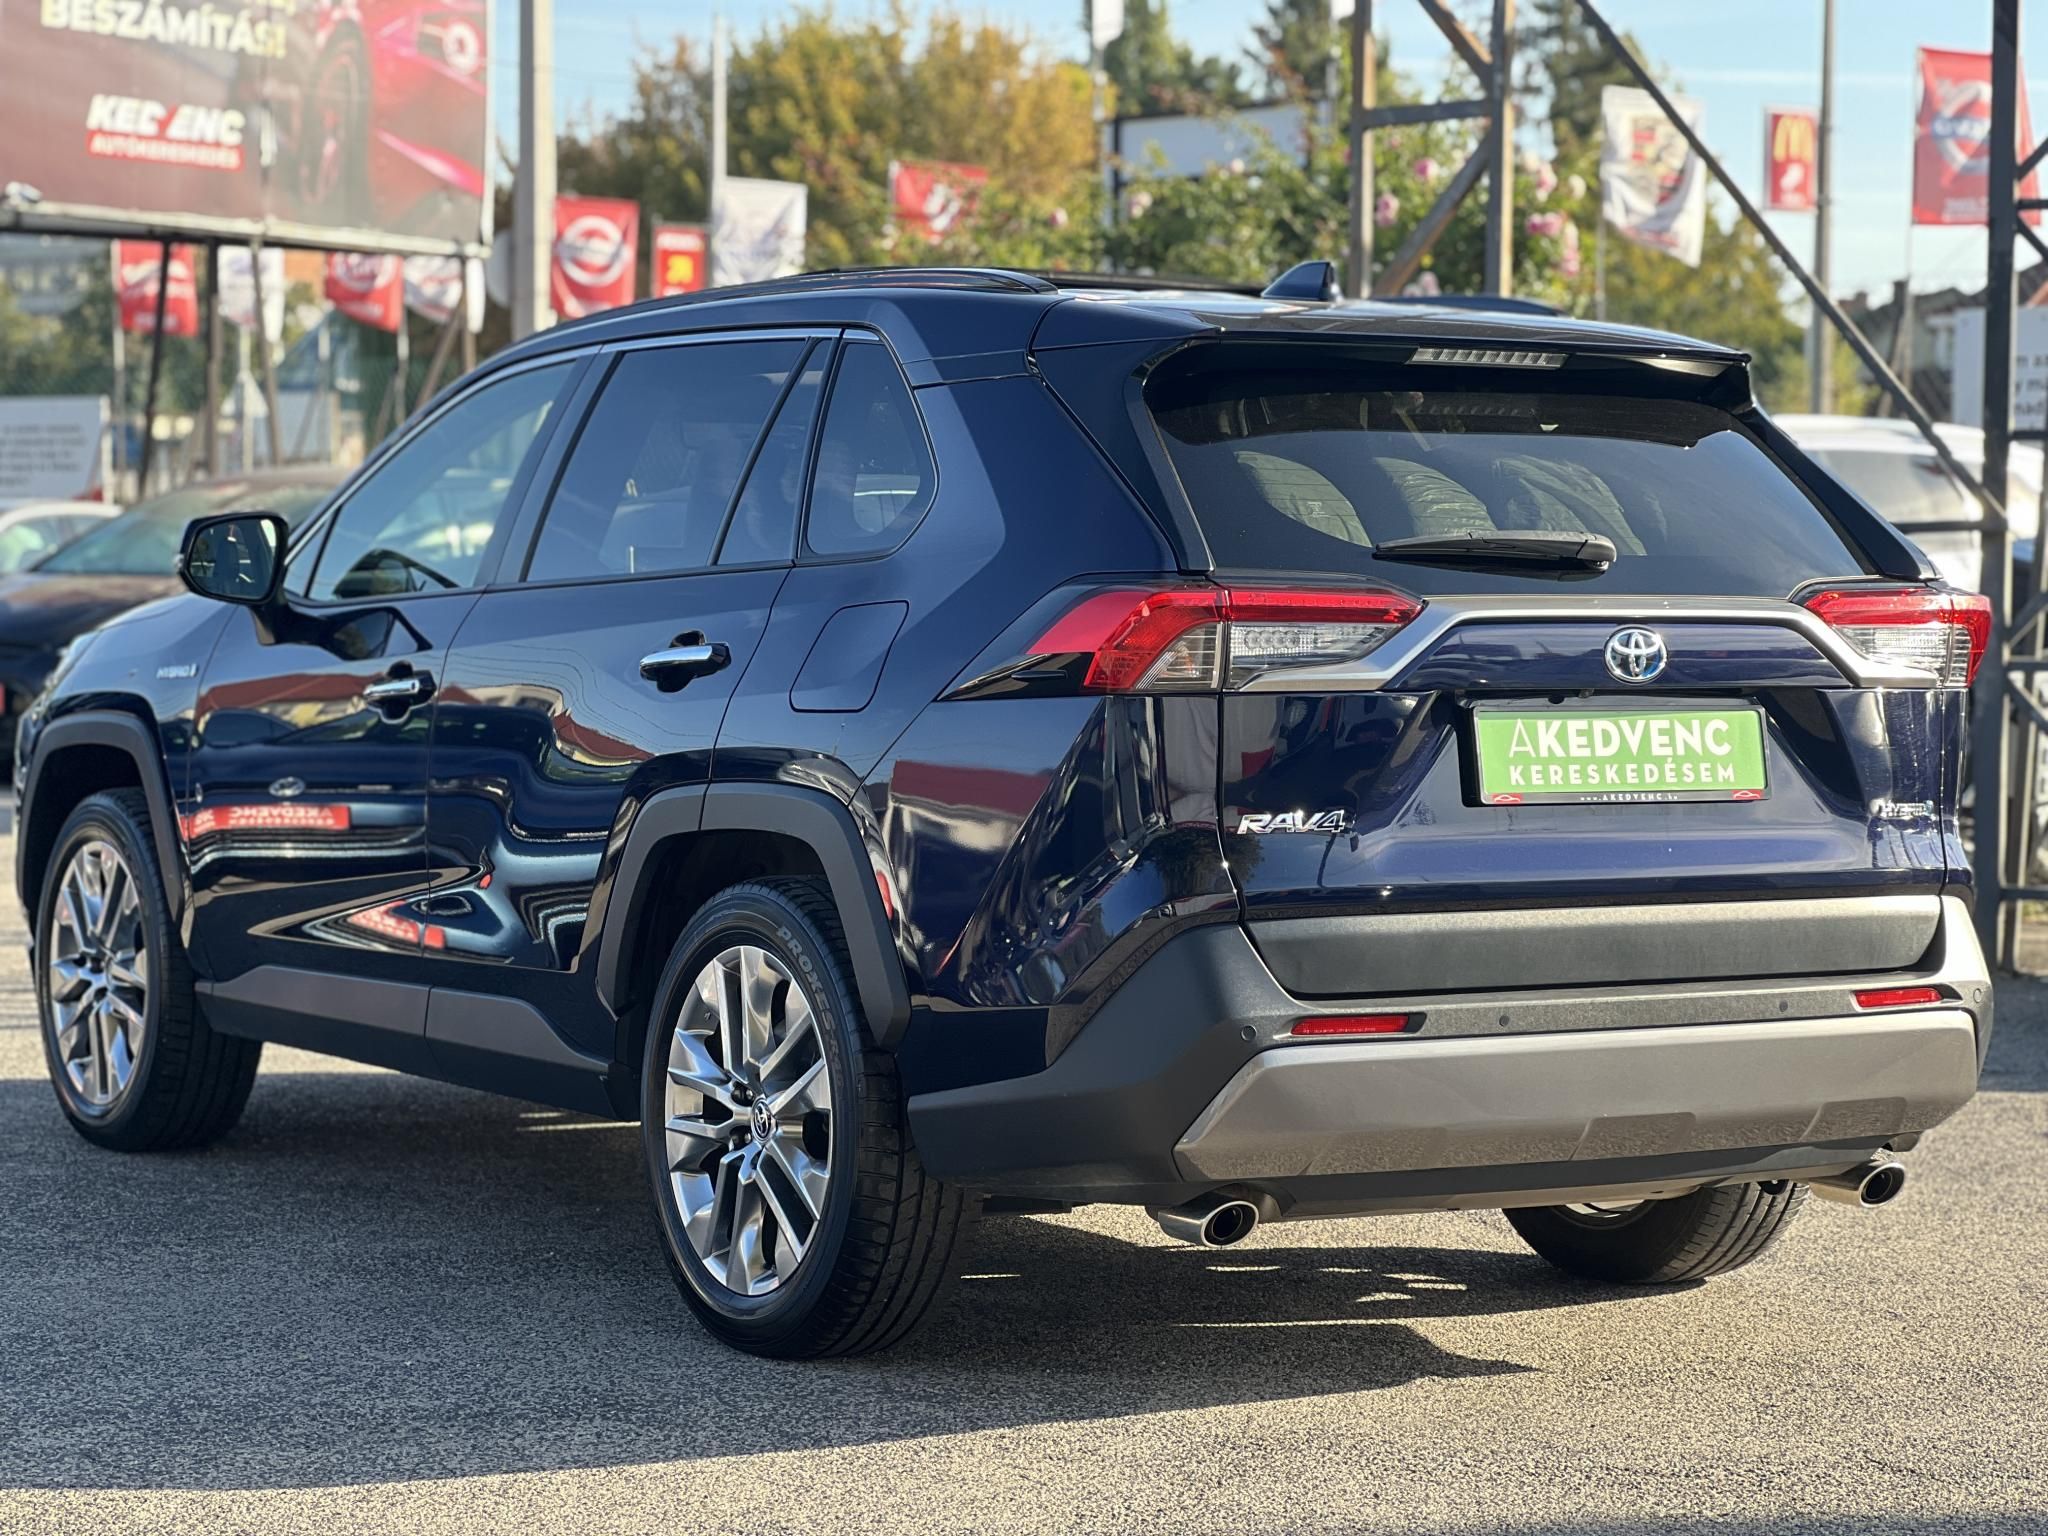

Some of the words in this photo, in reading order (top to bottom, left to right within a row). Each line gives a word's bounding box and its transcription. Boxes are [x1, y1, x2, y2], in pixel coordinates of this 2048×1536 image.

[1509, 757, 1735, 786] KERESKEDÉSEM
[1237, 809, 1345, 835] RAV4
[776, 925, 835, 1031] PROXES
